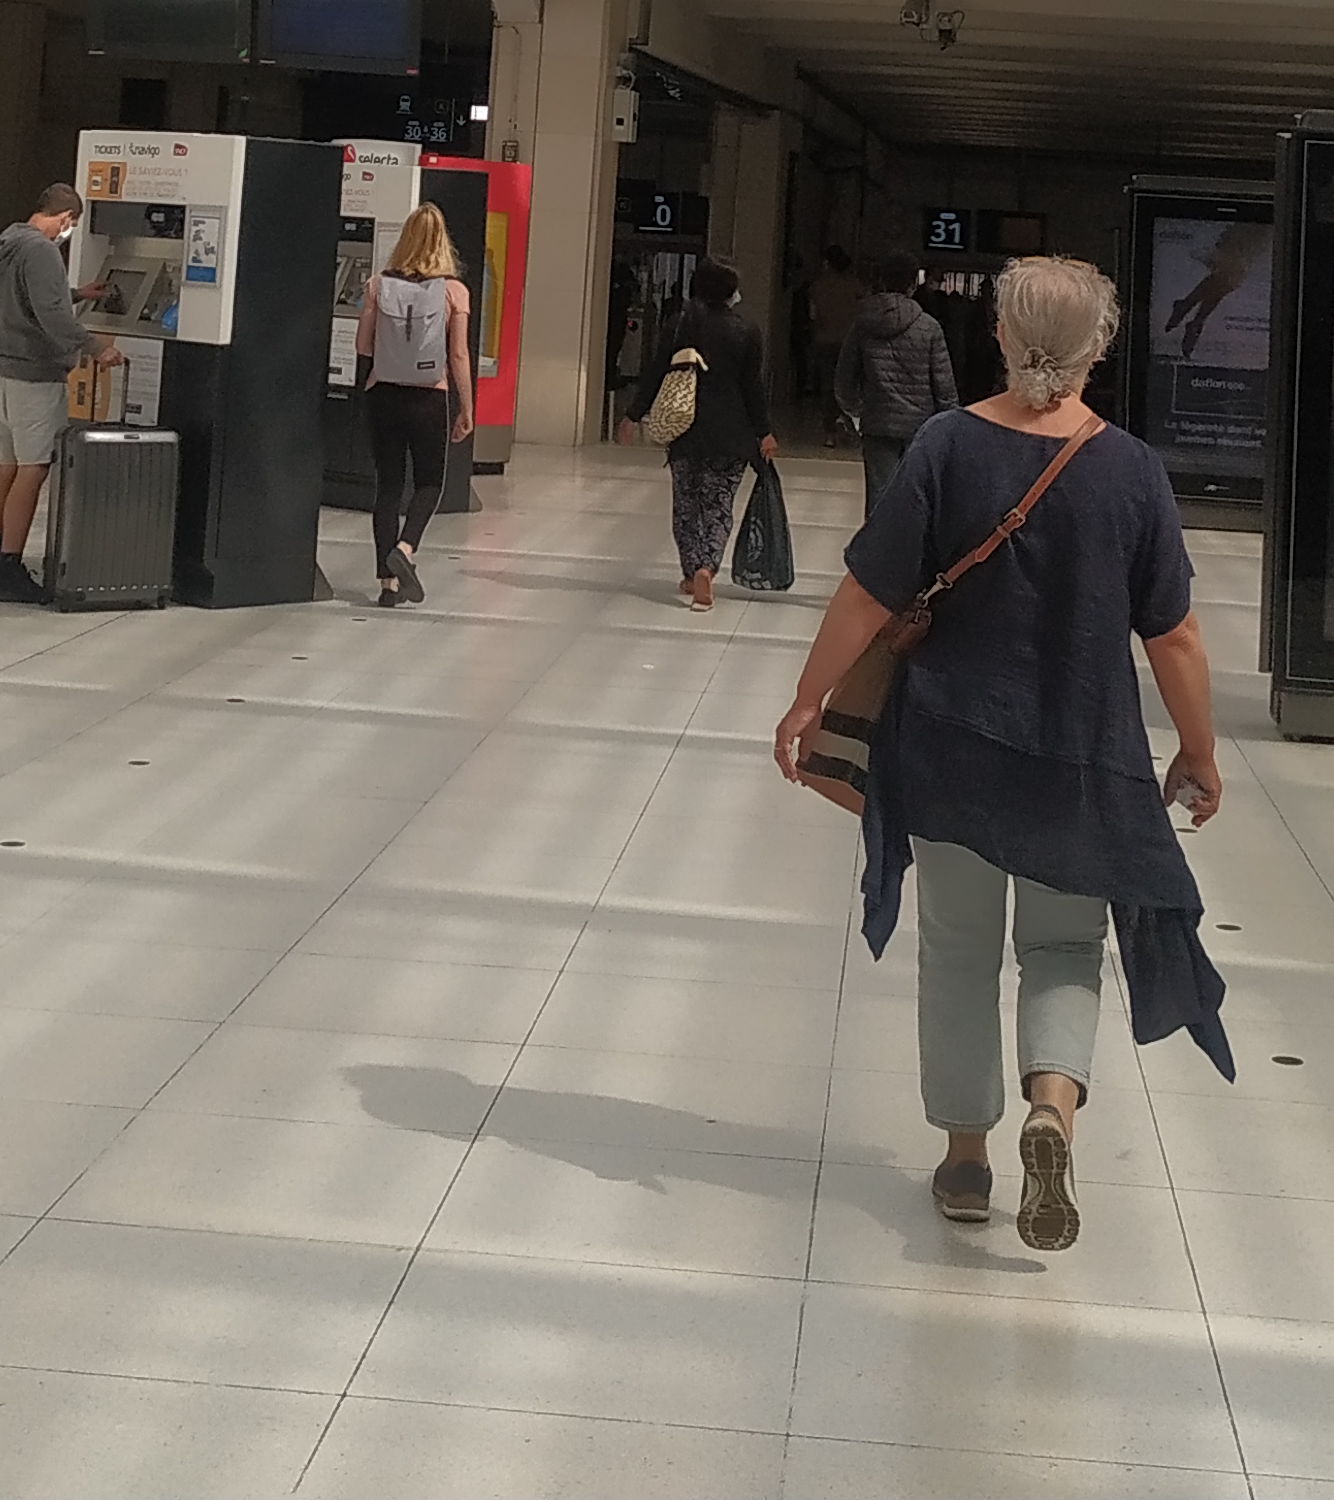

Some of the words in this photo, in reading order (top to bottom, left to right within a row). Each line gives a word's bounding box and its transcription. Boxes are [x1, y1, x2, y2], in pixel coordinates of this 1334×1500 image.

[404, 125, 422, 138] 30
[430, 127, 447, 139] 36
[94, 144, 122, 155] TICKETS
[358, 152, 399, 166] selecta
[929, 219, 962, 245] 31
